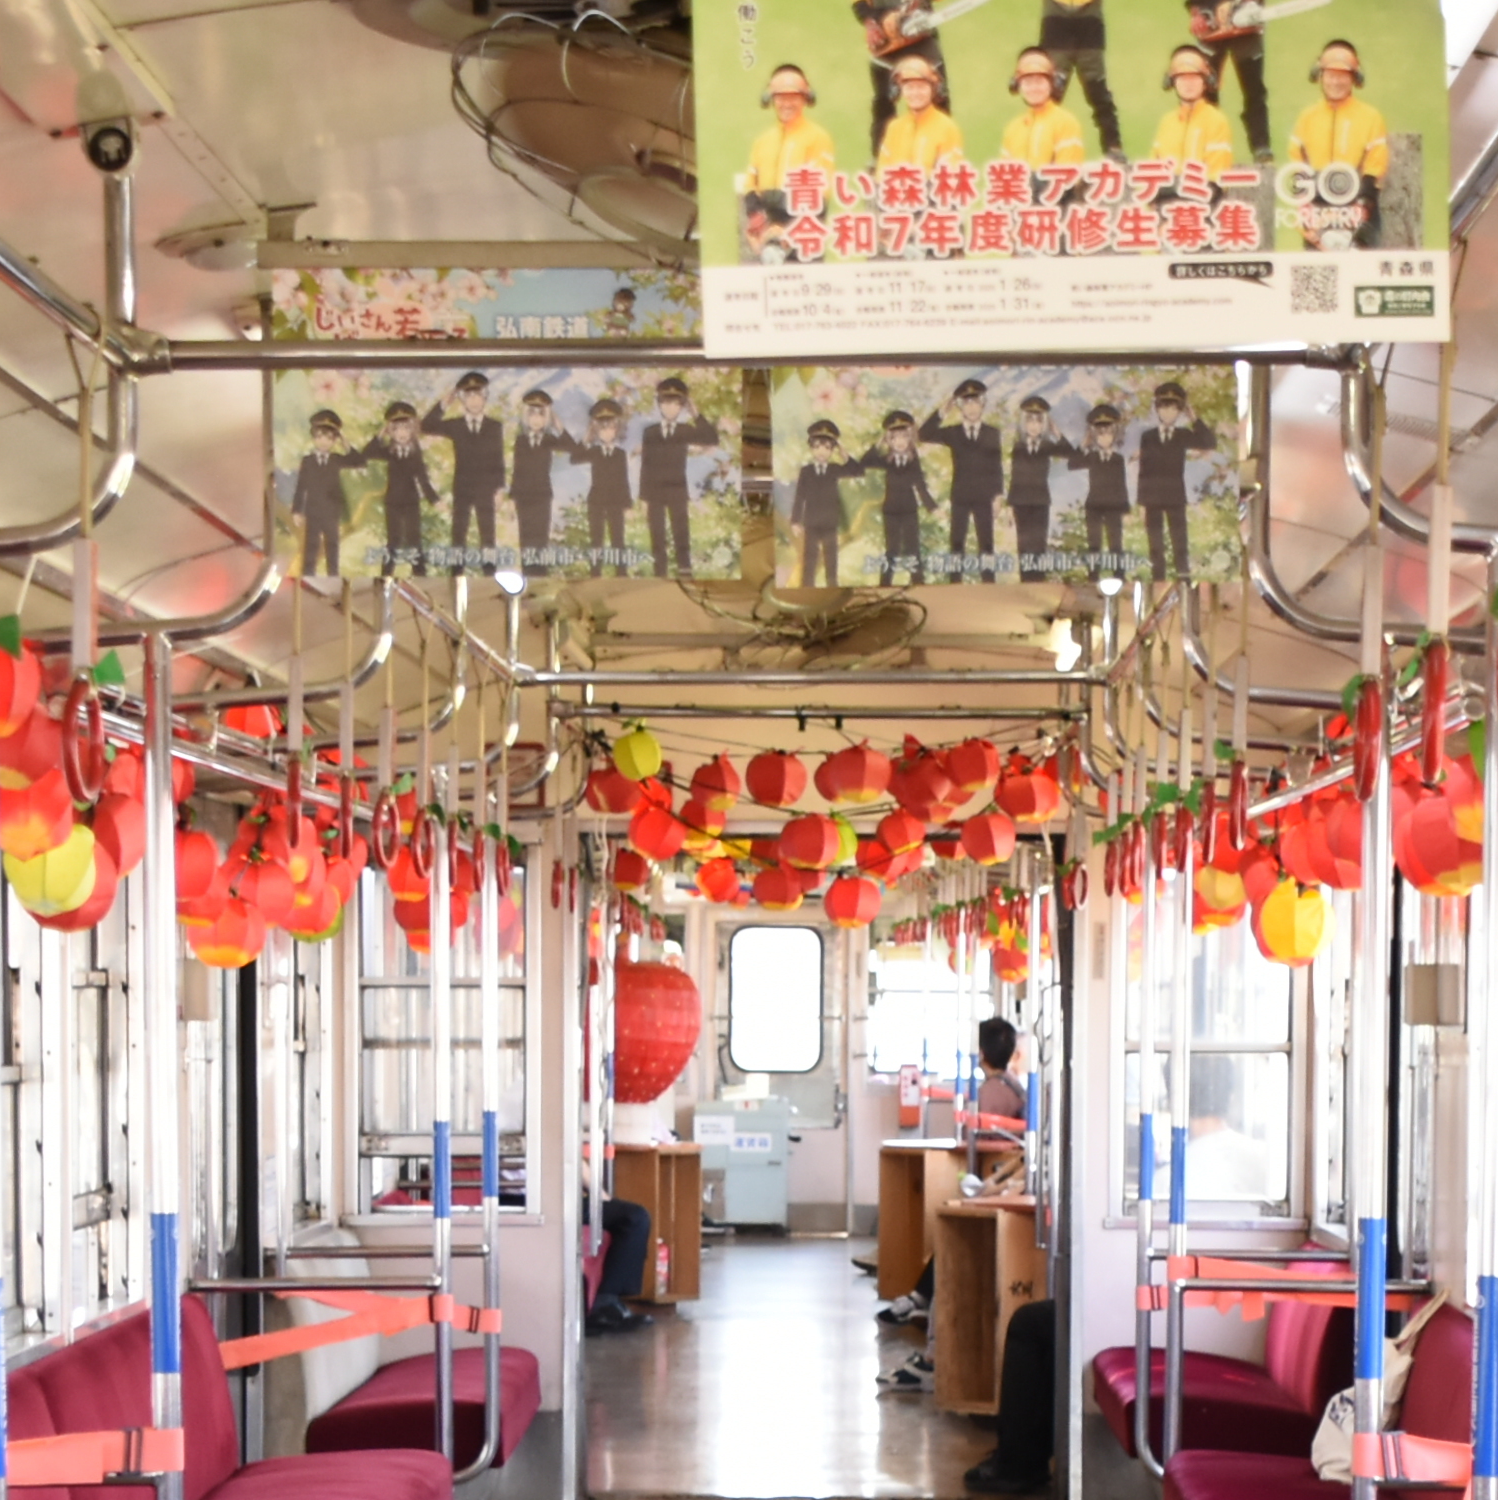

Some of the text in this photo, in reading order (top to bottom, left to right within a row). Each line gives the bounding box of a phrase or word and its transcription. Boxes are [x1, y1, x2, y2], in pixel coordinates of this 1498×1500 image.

[784, 160, 1257, 211] 青い森林業アカデミー
[1275, 162, 1360, 206] GO
[786, 204, 1257, 258] 令和7年度研修生募集
[1175, 263, 1268, 278] 詳しくはこちらから
[1379, 261, 1434, 276] 青森県
